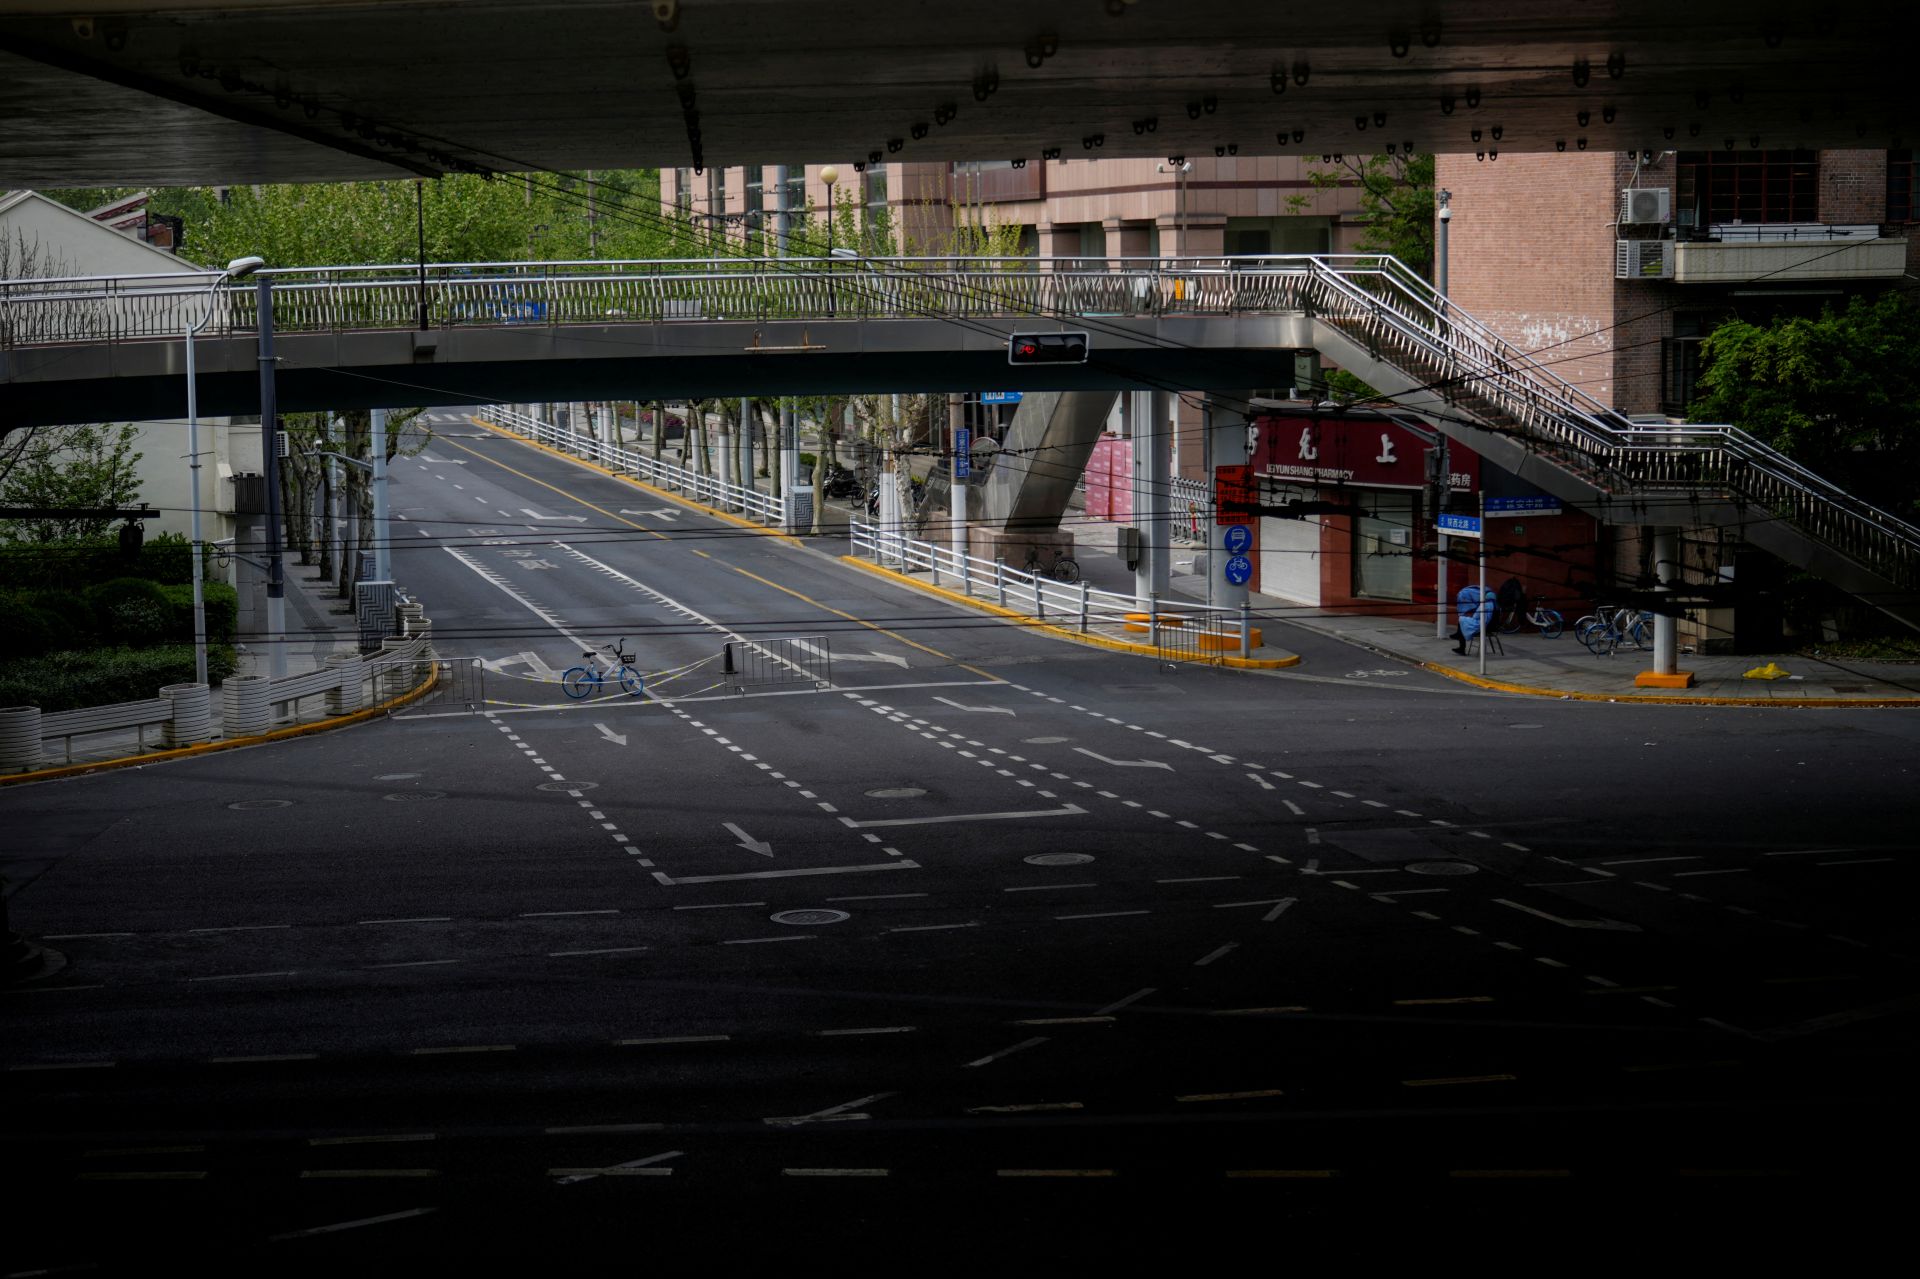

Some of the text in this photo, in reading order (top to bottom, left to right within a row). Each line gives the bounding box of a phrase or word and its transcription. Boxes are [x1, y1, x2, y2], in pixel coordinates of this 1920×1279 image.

[1447, 473, 1472, 487] 药房
[1448, 517, 1469, 529] 陕西北路
